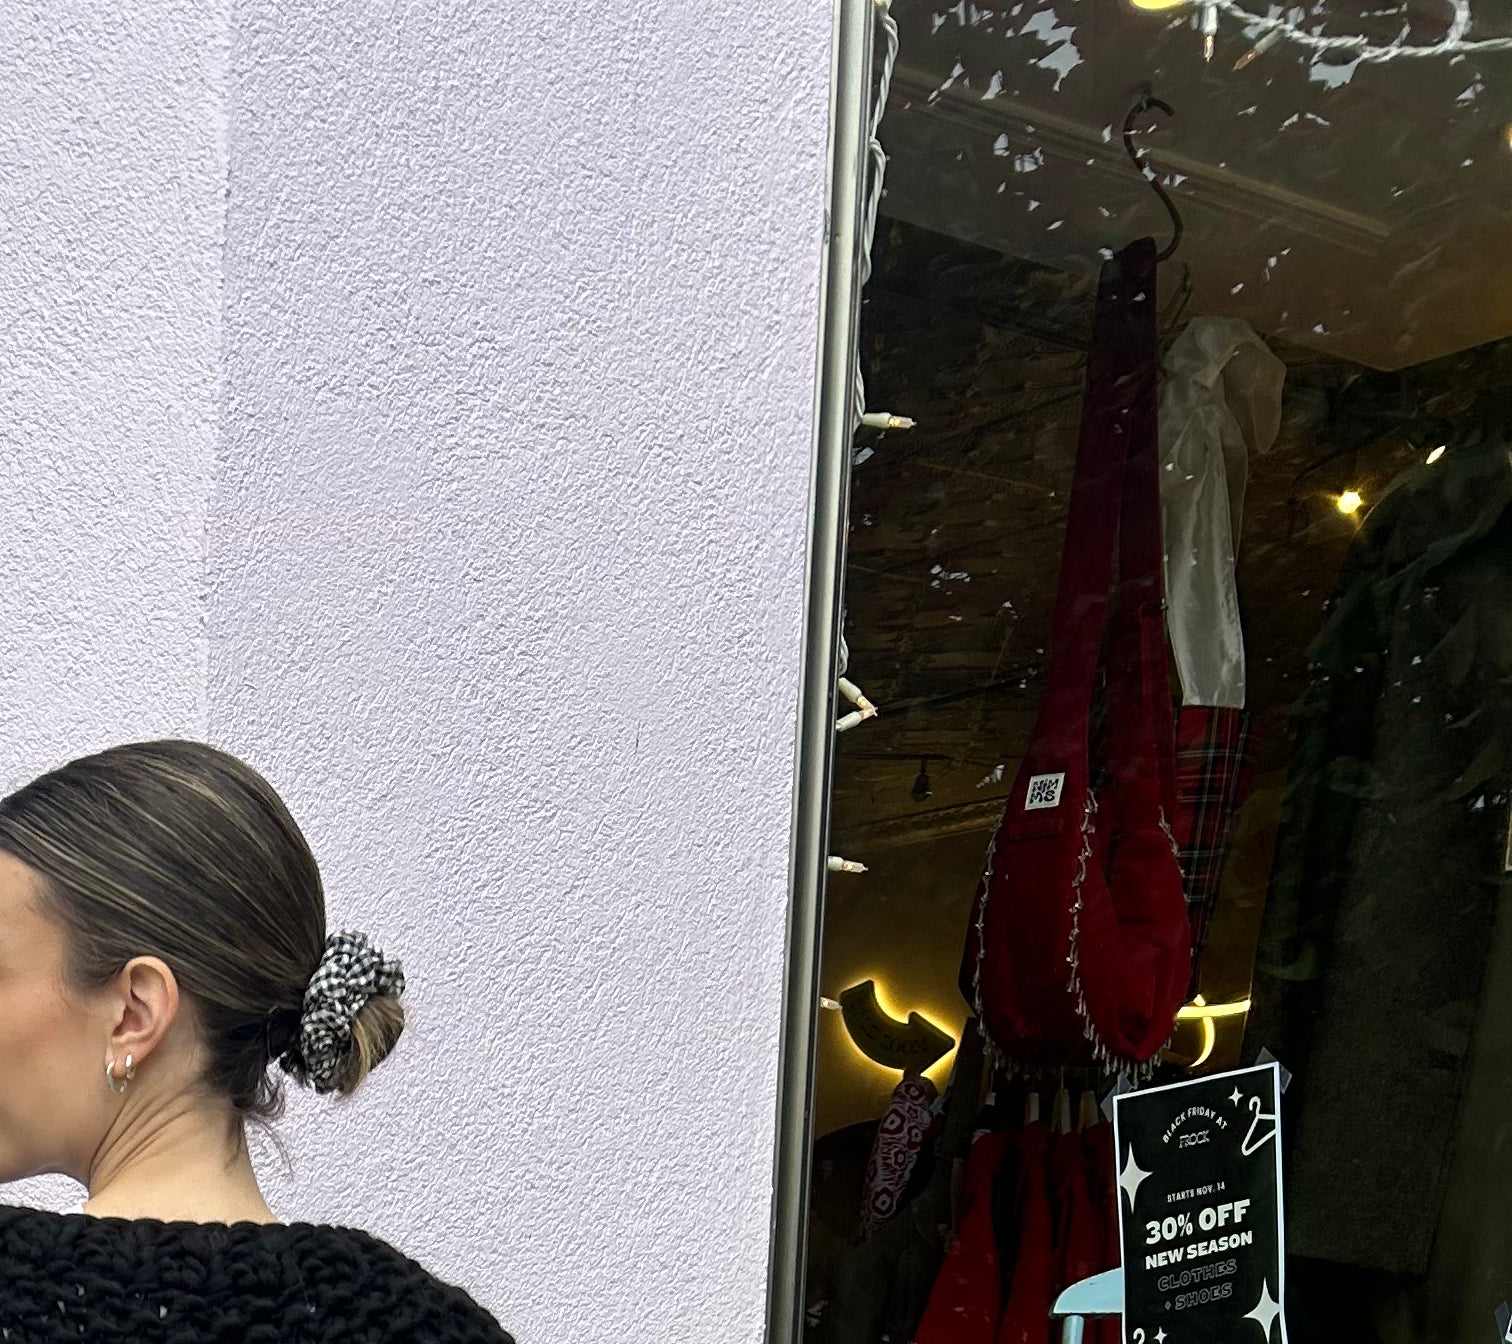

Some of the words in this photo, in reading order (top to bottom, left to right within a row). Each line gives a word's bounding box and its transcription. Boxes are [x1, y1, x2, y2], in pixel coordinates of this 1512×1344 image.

[1162, 1112, 1186, 1144] BLACK
[1187, 1106, 1216, 1120] FRIDAY
[1215, 1116, 1228, 1130] AT
[1167, 1188, 1195, 1203] STARTS
[1145, 1212, 1193, 1245] 30%
[1198, 1199, 1251, 1231] OFF
[1145, 1247, 1184, 1270] NEW
[1186, 1230, 1253, 1260] SEASON
[1157, 1259, 1238, 1292] CLOTHES
[1175, 1282, 1233, 1310] SHOES
